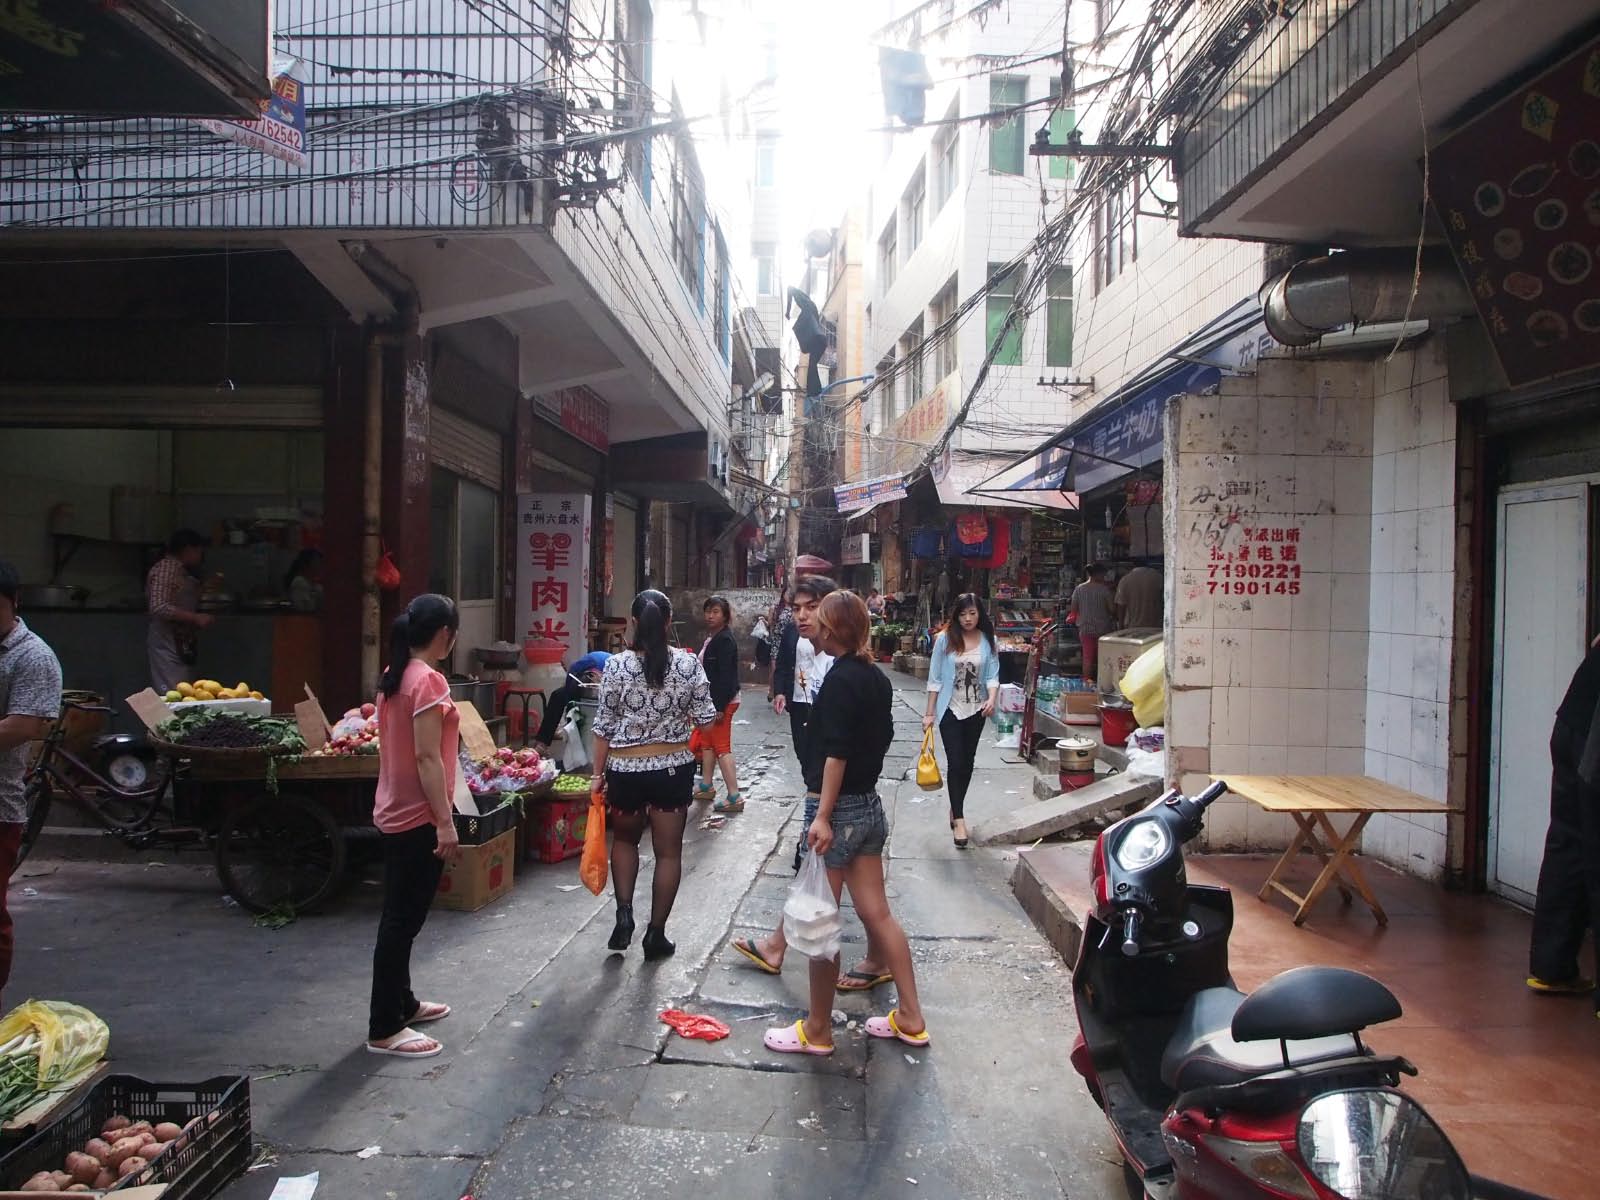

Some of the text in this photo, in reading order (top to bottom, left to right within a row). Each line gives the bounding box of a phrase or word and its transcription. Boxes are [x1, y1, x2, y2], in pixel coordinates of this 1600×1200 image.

[523, 512, 580, 525] 贵州六盘水
[1207, 564, 1301, 578] 7190221
[1207, 581, 1300, 595] 7190145
